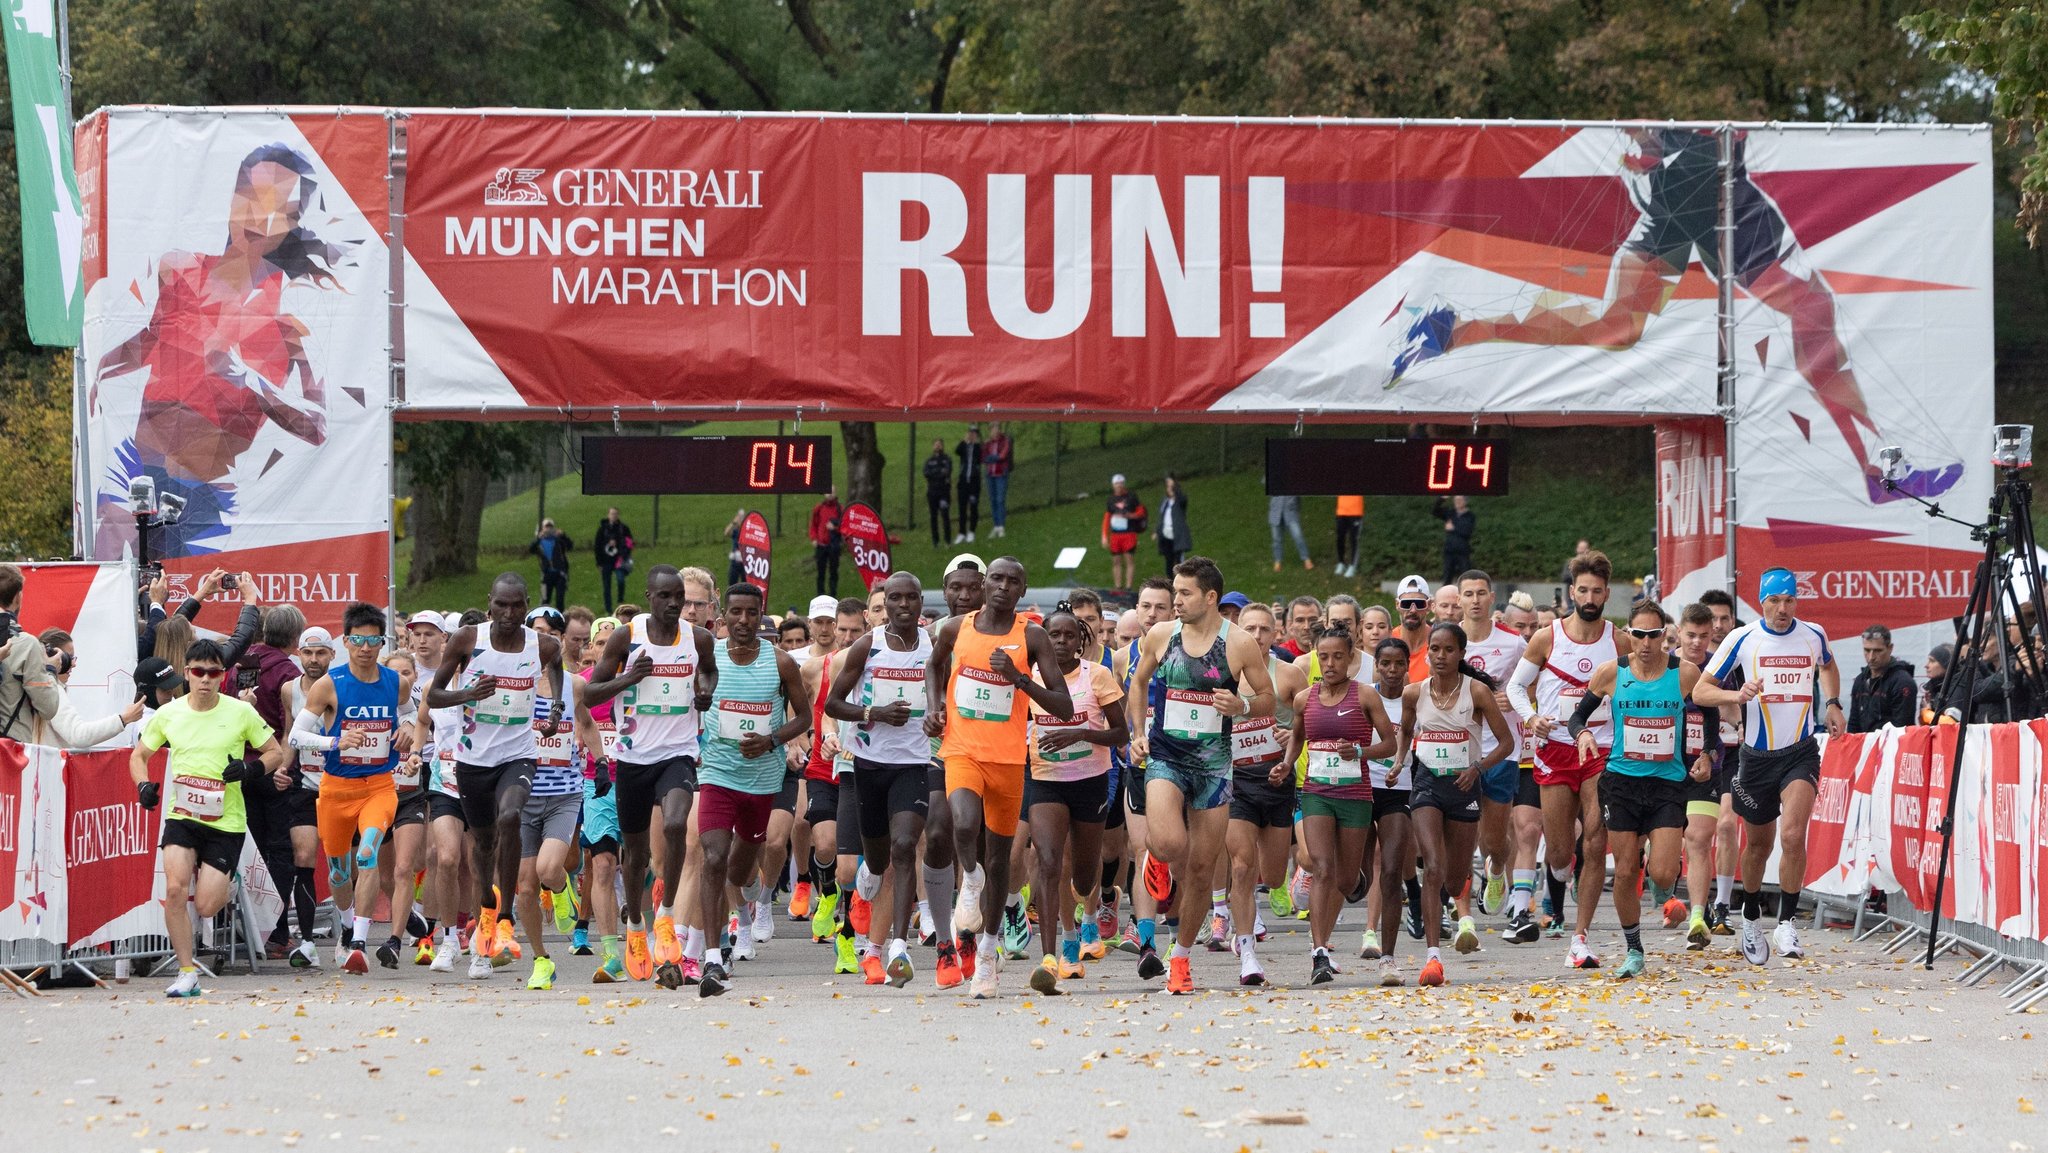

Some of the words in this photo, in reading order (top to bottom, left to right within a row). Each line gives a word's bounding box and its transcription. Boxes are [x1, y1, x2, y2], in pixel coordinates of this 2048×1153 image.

[552, 168, 764, 208] GENERALI
[445, 216, 705, 257] MÜNCHEN
[862, 171, 1286, 340] RUN!
[552, 267, 807, 307] MARATHON
[749, 442, 814, 488] 04
[1428, 444, 1491, 489] 04
[1661, 455, 1723, 538] RUN!
[854, 545, 889, 573] 3:00
[744, 554, 769, 579] 3:00
[1821, 569, 1971, 599] GENERALI
[1775, 657, 1807, 665] GENERALI
[654, 665, 689, 674] GENERALI
[889, 669, 924, 678] GENERALI
[1774, 673, 1801, 684] 1007
[662, 682, 670, 694] 3
[897, 686, 904, 697] 1
[502, 695, 510, 706] 5
[975, 688, 990, 701] 15
[1182, 693, 1215, 702] GENERA
[344, 705, 393, 718] CATL
[735, 702, 771, 712] GENERALI
[1047, 714, 1084, 724] GENALI
[1190, 709, 1199, 721] 8
[356, 721, 389, 730] GENERALI
[739, 719, 755, 731] 20
[1237, 717, 1271, 731] GENERALI
[1637, 718, 1671, 727] GENERALI
[1238, 734, 1268, 748] 1644
[1430, 731, 1464, 740] GENERALI
[1639, 733, 1660, 744] 421
[1435, 747, 1448, 758] 11
[1326, 756, 1340, 768] 12
[185, 776, 222, 790] GENERALI
[187, 792, 206, 805] 211
[72, 801, 149, 867] GENERALI
